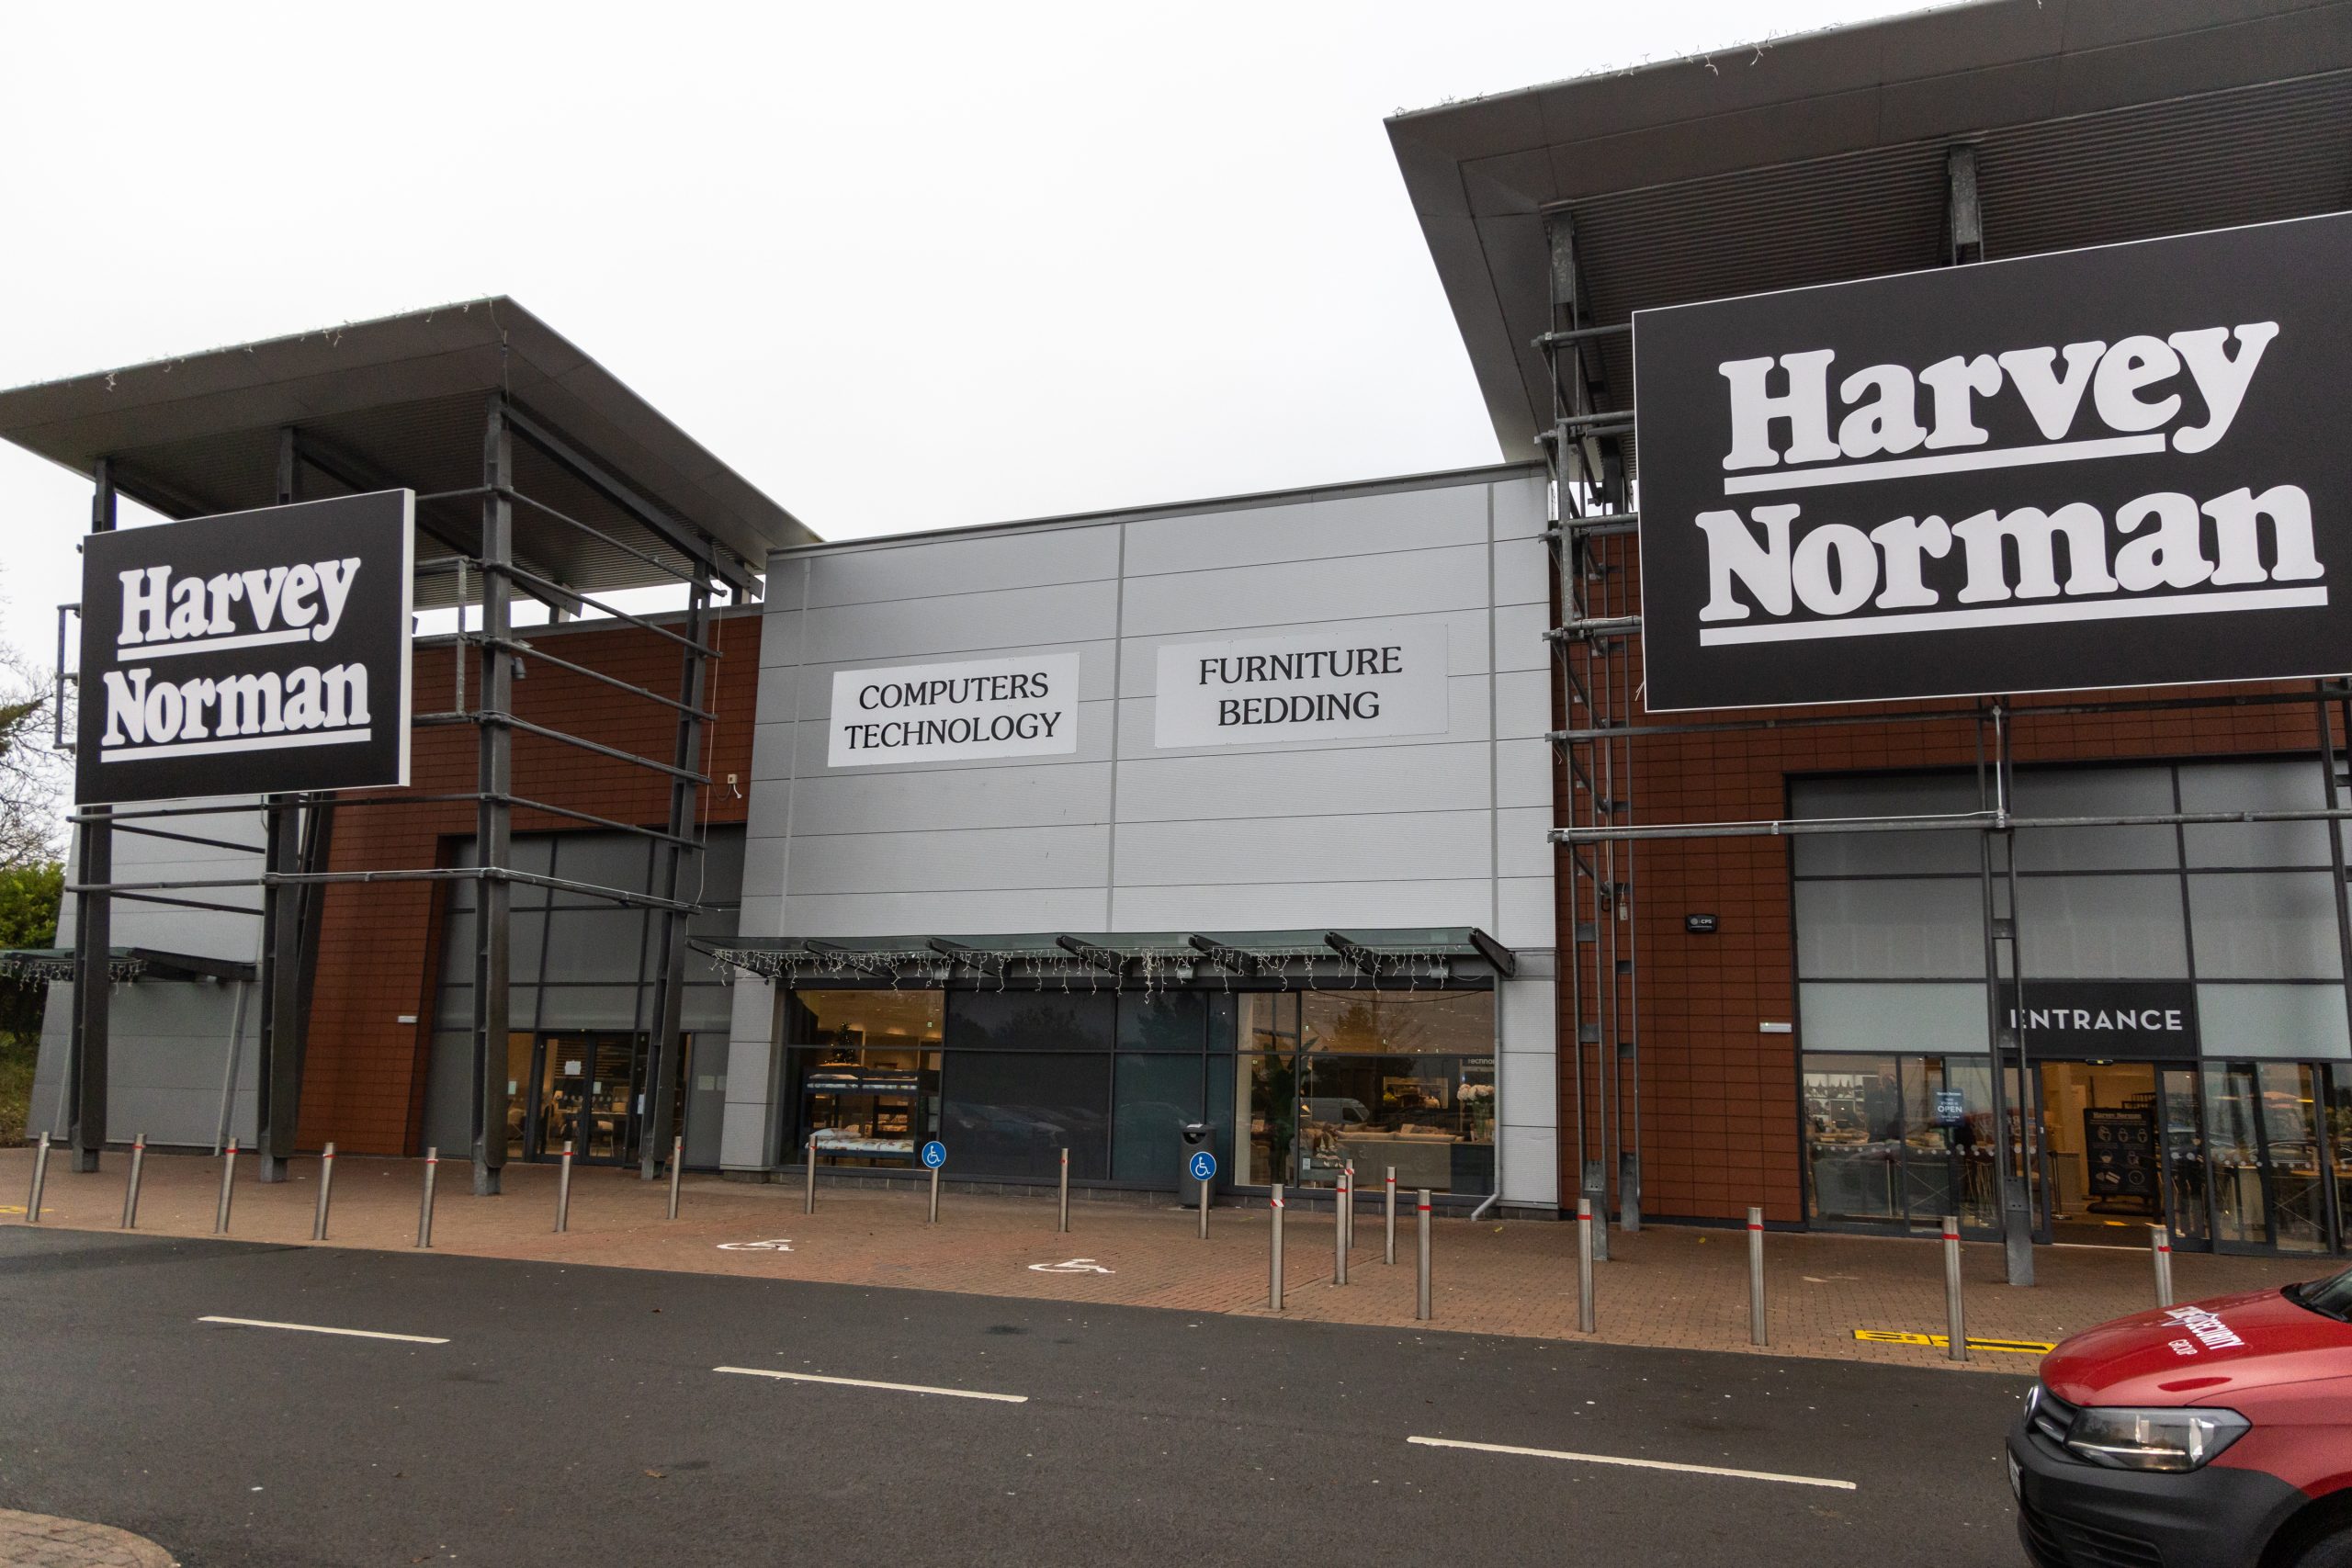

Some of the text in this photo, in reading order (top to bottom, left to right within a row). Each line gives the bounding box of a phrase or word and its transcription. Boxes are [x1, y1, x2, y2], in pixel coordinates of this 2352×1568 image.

[1718, 321, 2280, 470] Harvey
[1695, 484, 2325, 622] Norman
[117, 557, 362, 645] Harvey
[1198, 646, 1403, 686] FURNITURE
[101, 662, 371, 746] Norman
[858, 671, 1049, 711] COMPUTERS
[1217, 690, 1381, 728] BEDDING
[843, 711, 1063, 750] TECHNOLOGY
[1938, 1105, 1962, 1113] OPEN
[2168, 1338, 2198, 1355] GROUP
[2186, 1317, 2245, 1350] SECURITY
